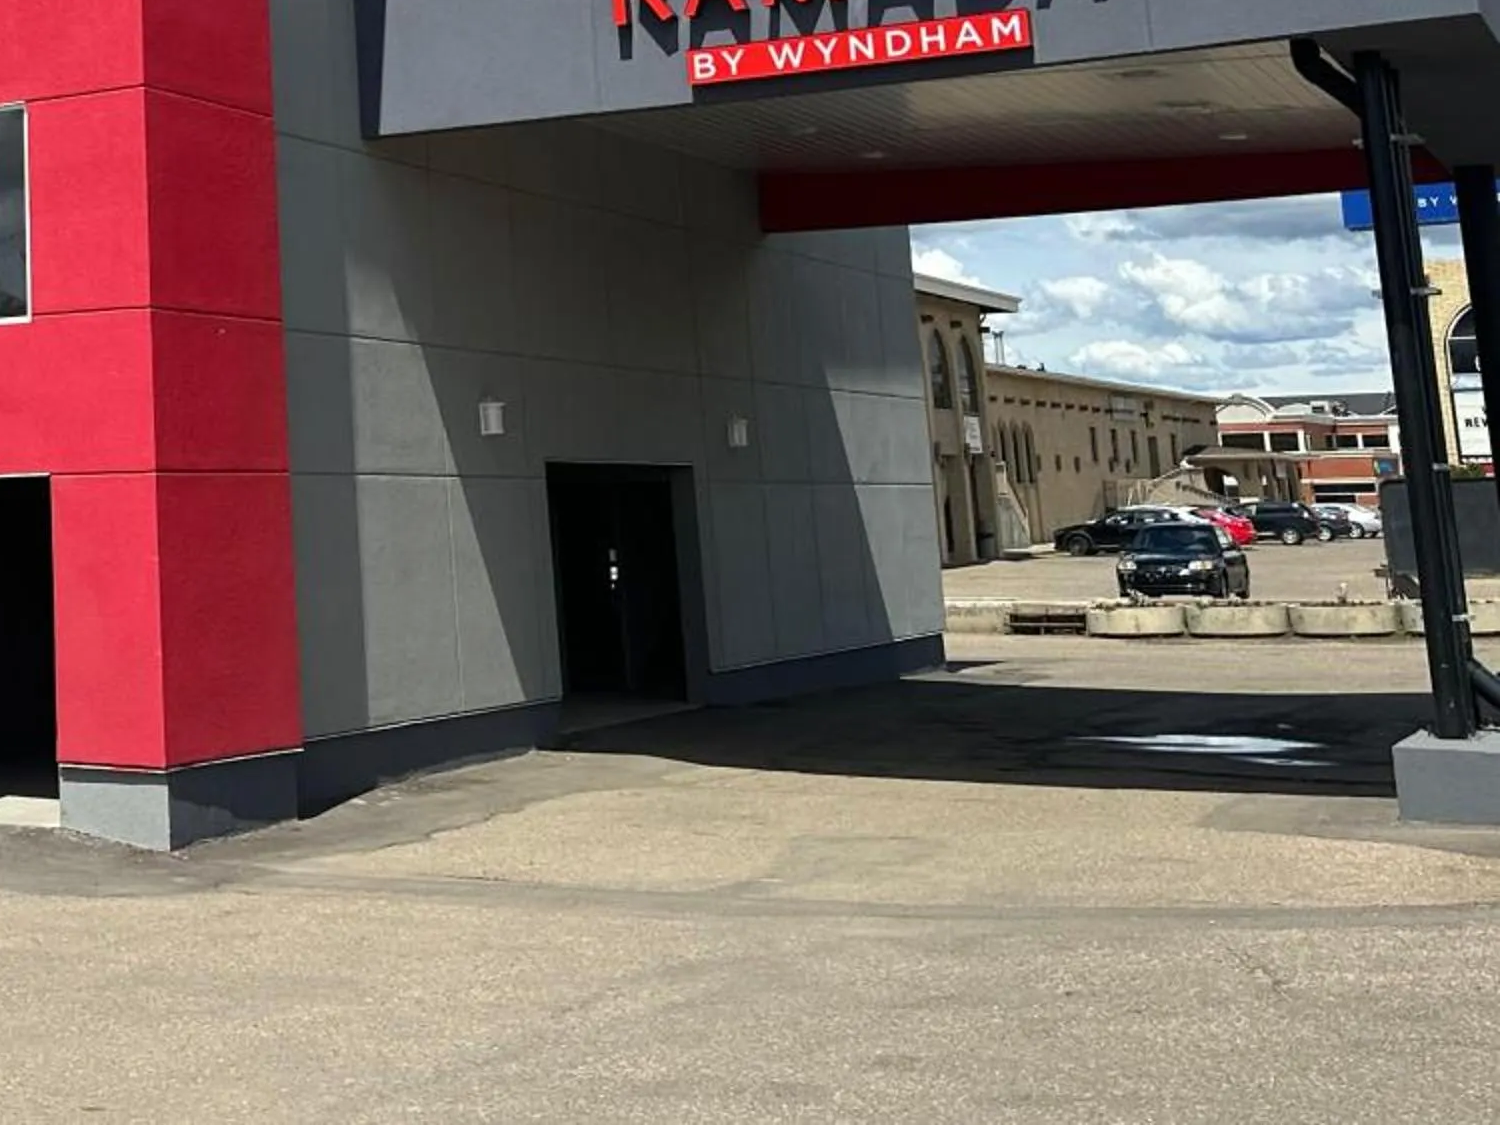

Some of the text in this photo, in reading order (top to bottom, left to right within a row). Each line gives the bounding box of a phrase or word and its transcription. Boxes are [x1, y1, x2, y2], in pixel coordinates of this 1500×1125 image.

[693, 14, 1023, 80] BY WYNDHAM
[1417, 195, 1440, 208] BY
